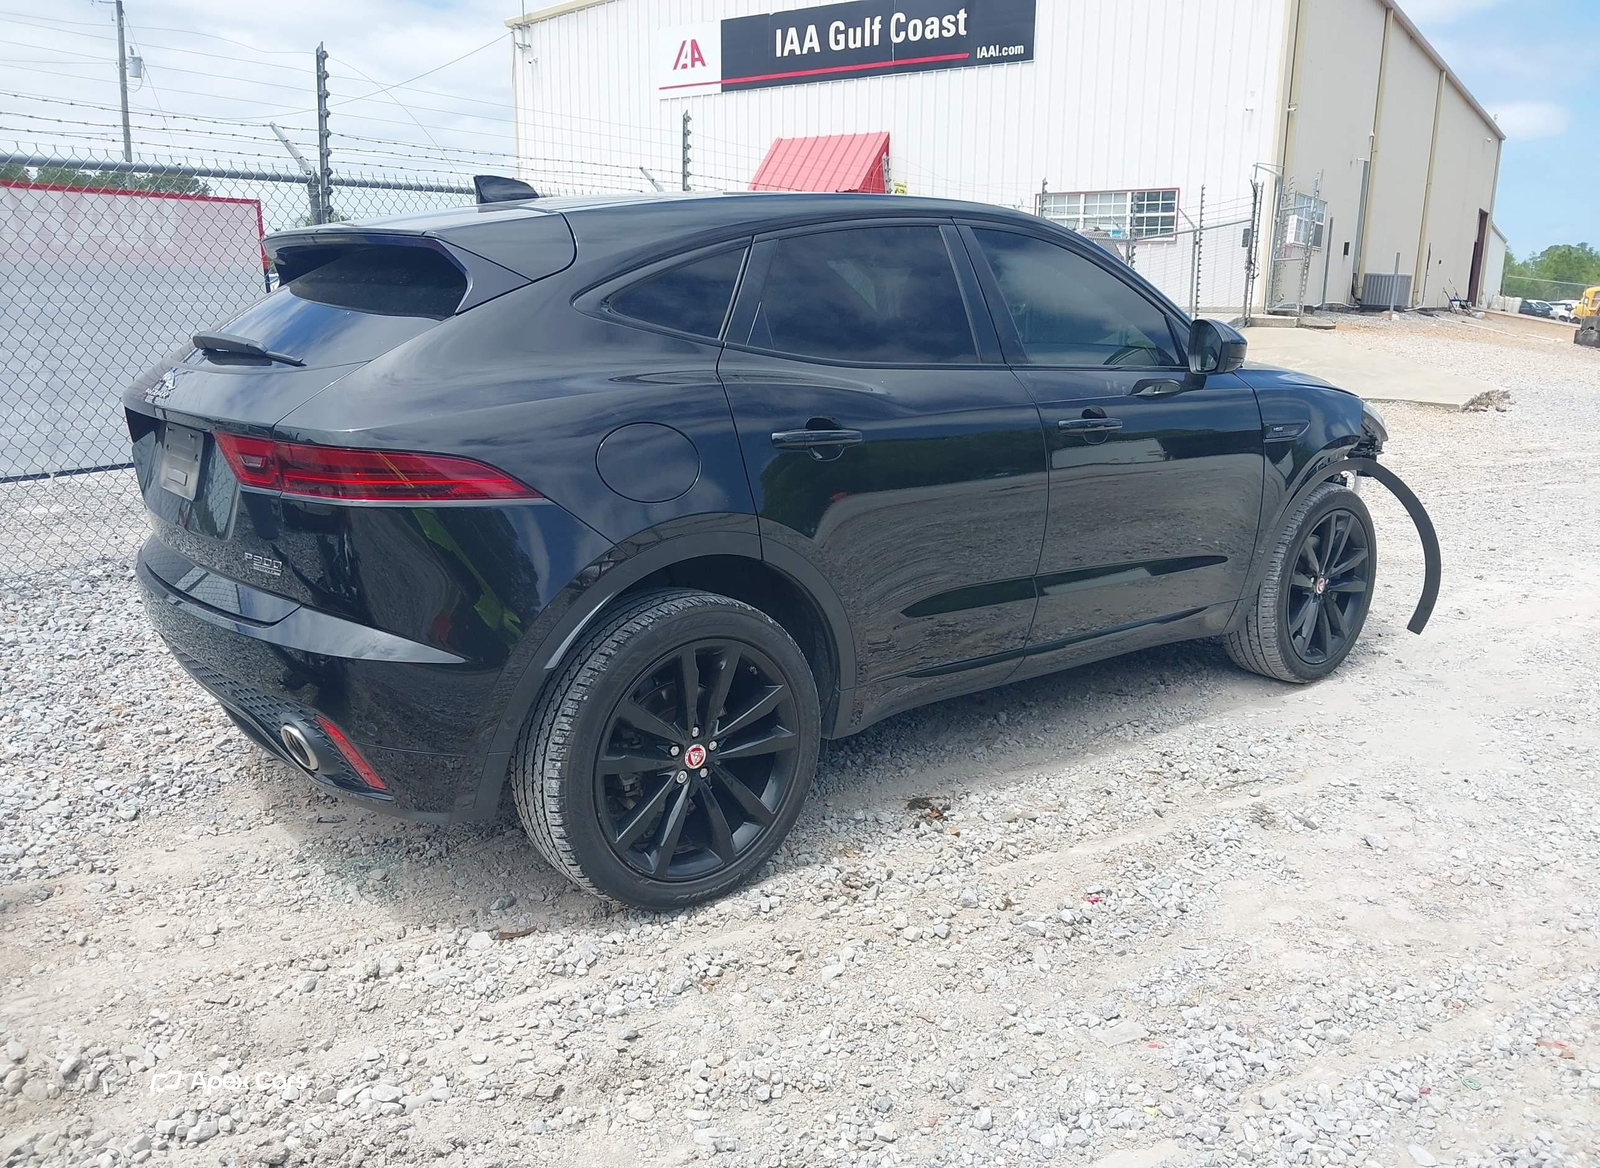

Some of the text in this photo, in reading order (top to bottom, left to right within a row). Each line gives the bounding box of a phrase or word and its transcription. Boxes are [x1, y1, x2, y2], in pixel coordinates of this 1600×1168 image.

[774, 7, 969, 58] IAA Gulf Coast
[975, 44, 1025, 59] IAAI.com
